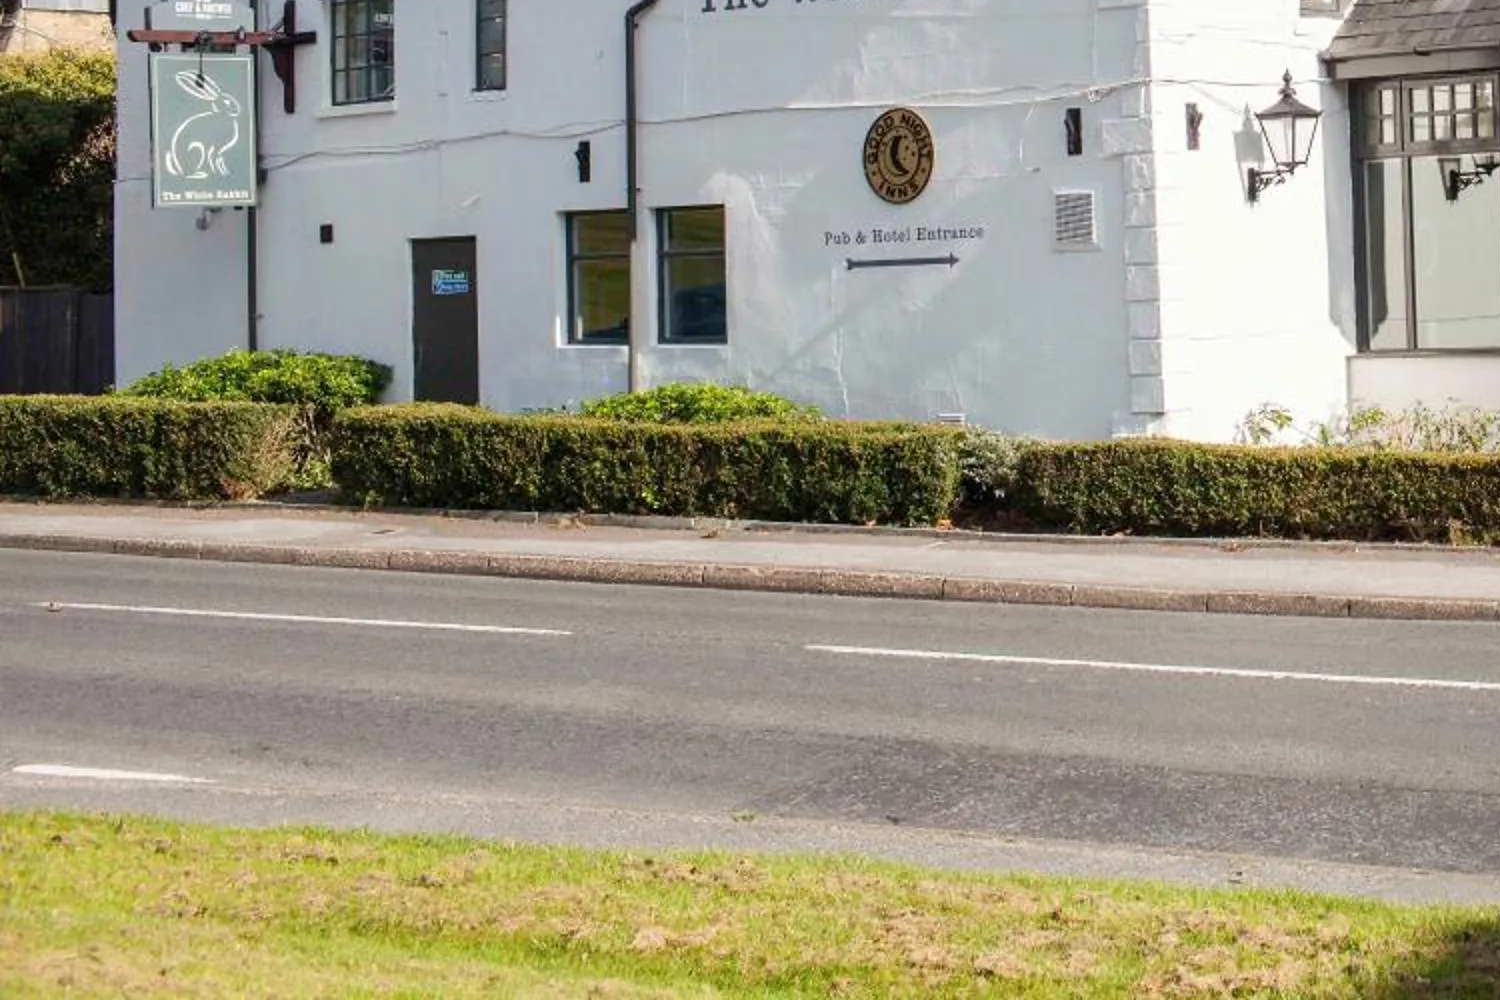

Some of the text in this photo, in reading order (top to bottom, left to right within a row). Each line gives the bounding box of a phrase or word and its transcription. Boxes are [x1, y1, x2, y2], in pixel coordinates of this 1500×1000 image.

[866, 112, 931, 165] GOOD NIGHT
[878, 182, 918, 198] INNS
[824, 226, 985, 246] Pub & Hotel Entrance
